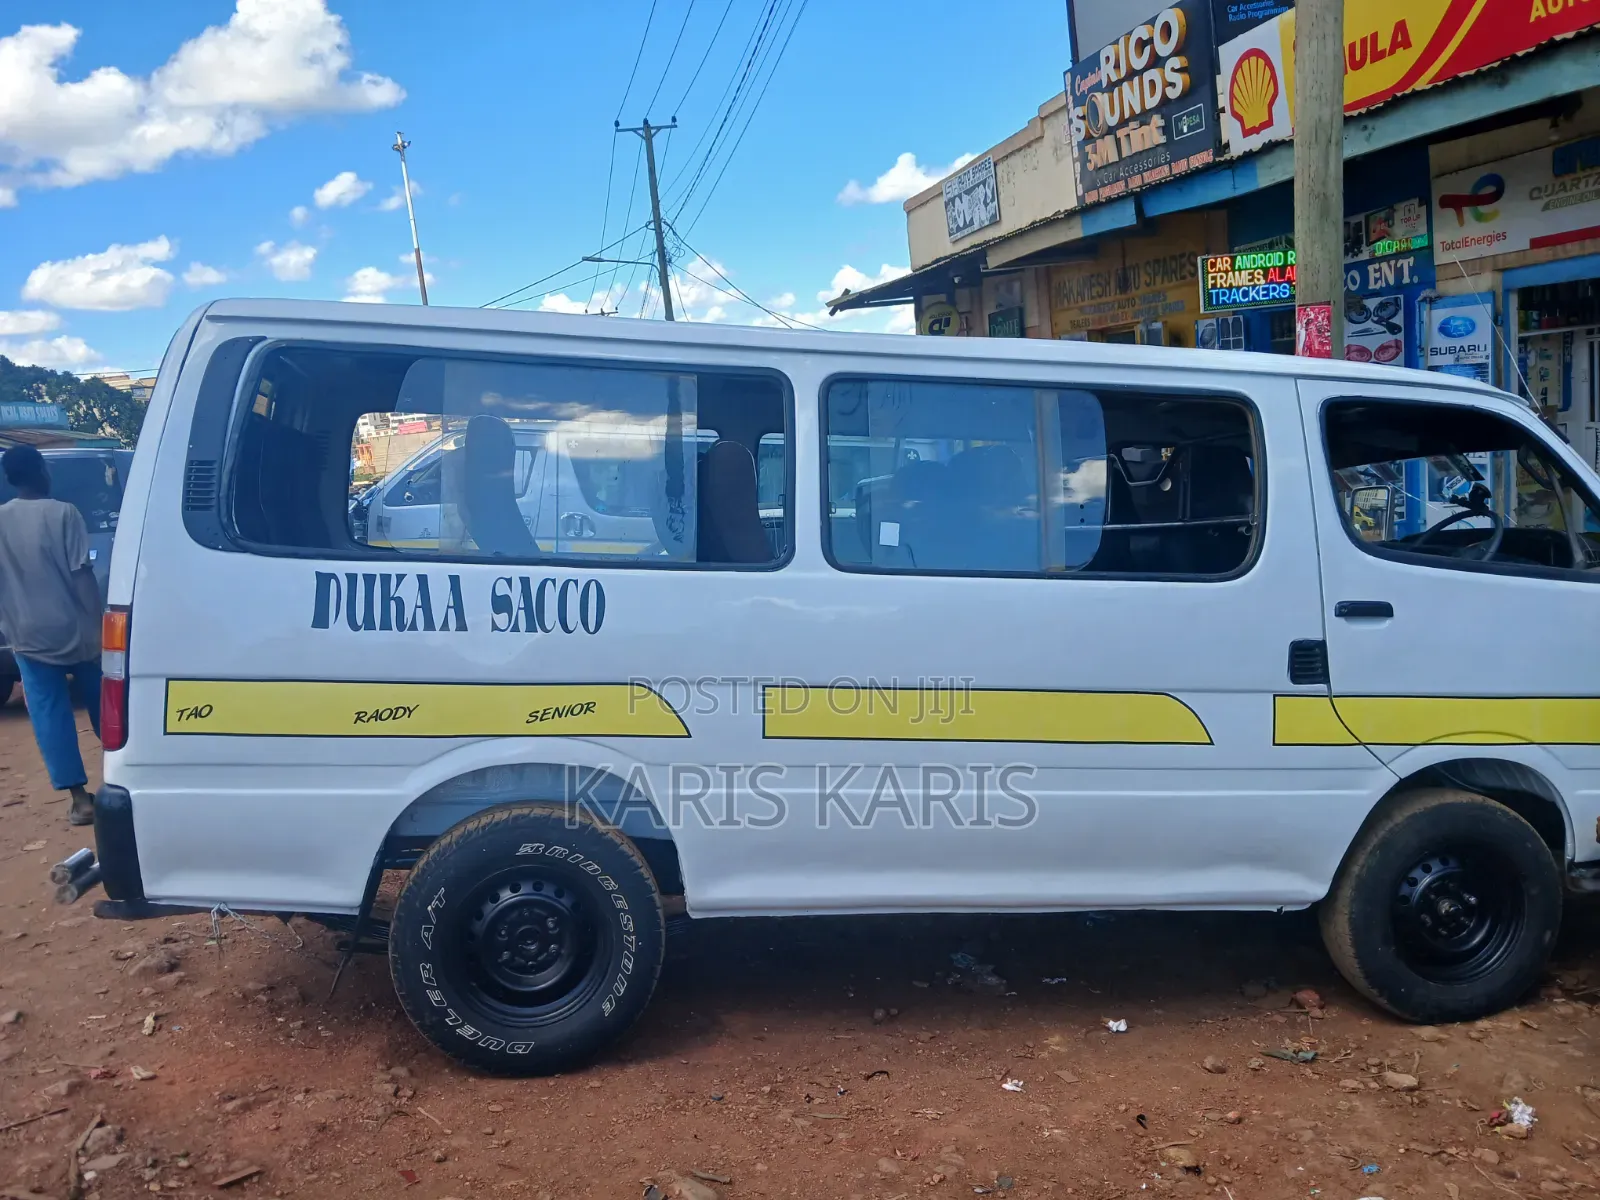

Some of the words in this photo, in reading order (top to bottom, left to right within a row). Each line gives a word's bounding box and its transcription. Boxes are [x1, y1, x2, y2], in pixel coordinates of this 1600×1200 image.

[1228, 12, 1246, 22] Radio
[1247, 5, 1288, 19] Programming
[1240, 0, 1275, 11] Accessories
[1100, 8, 1186, 88] RICO
[1343, 18, 1412, 75] ULA
[1072, 56, 1190, 142] SOUNDS
[1116, 113, 1167, 158] Tint
[1177, 114, 1201, 132] MPESA
[1103, 171, 1117, 184] Car
[1119, 151, 1171, 178] Accessories
[1550, 193, 1580, 209] ENGINE
[1583, 191, 1598, 203] OIL
[1440, 230, 1507, 252] TotalEnergies
[1144, 251, 1198, 287] SPARES
[1208, 257, 1232, 272] CAR
[1235, 252, 1284, 270] ANDROID
[1288, 250, 1296, 264] R
[1267, 265, 1296, 283] ALA
[1343, 270, 1360, 291] O
[1367, 256, 1420, 290] ENT.
[1117, 298, 1136, 310] AUTO
[1209, 284, 1290, 305] TRACKERS
[1430, 344, 1487, 356] SUBARU
[310, 570, 468, 632] DUKAA
[490, 576, 606, 634] SACCO
[175, 704, 213, 722] TAO
[353, 704, 420, 724] RAODY
[526, 701, 597, 724] SENIOR
[421, 887, 447, 950] A/T
[516, 843, 636, 1017] BRIDGESTONE
[419, 963, 535, 1054] DUELER
